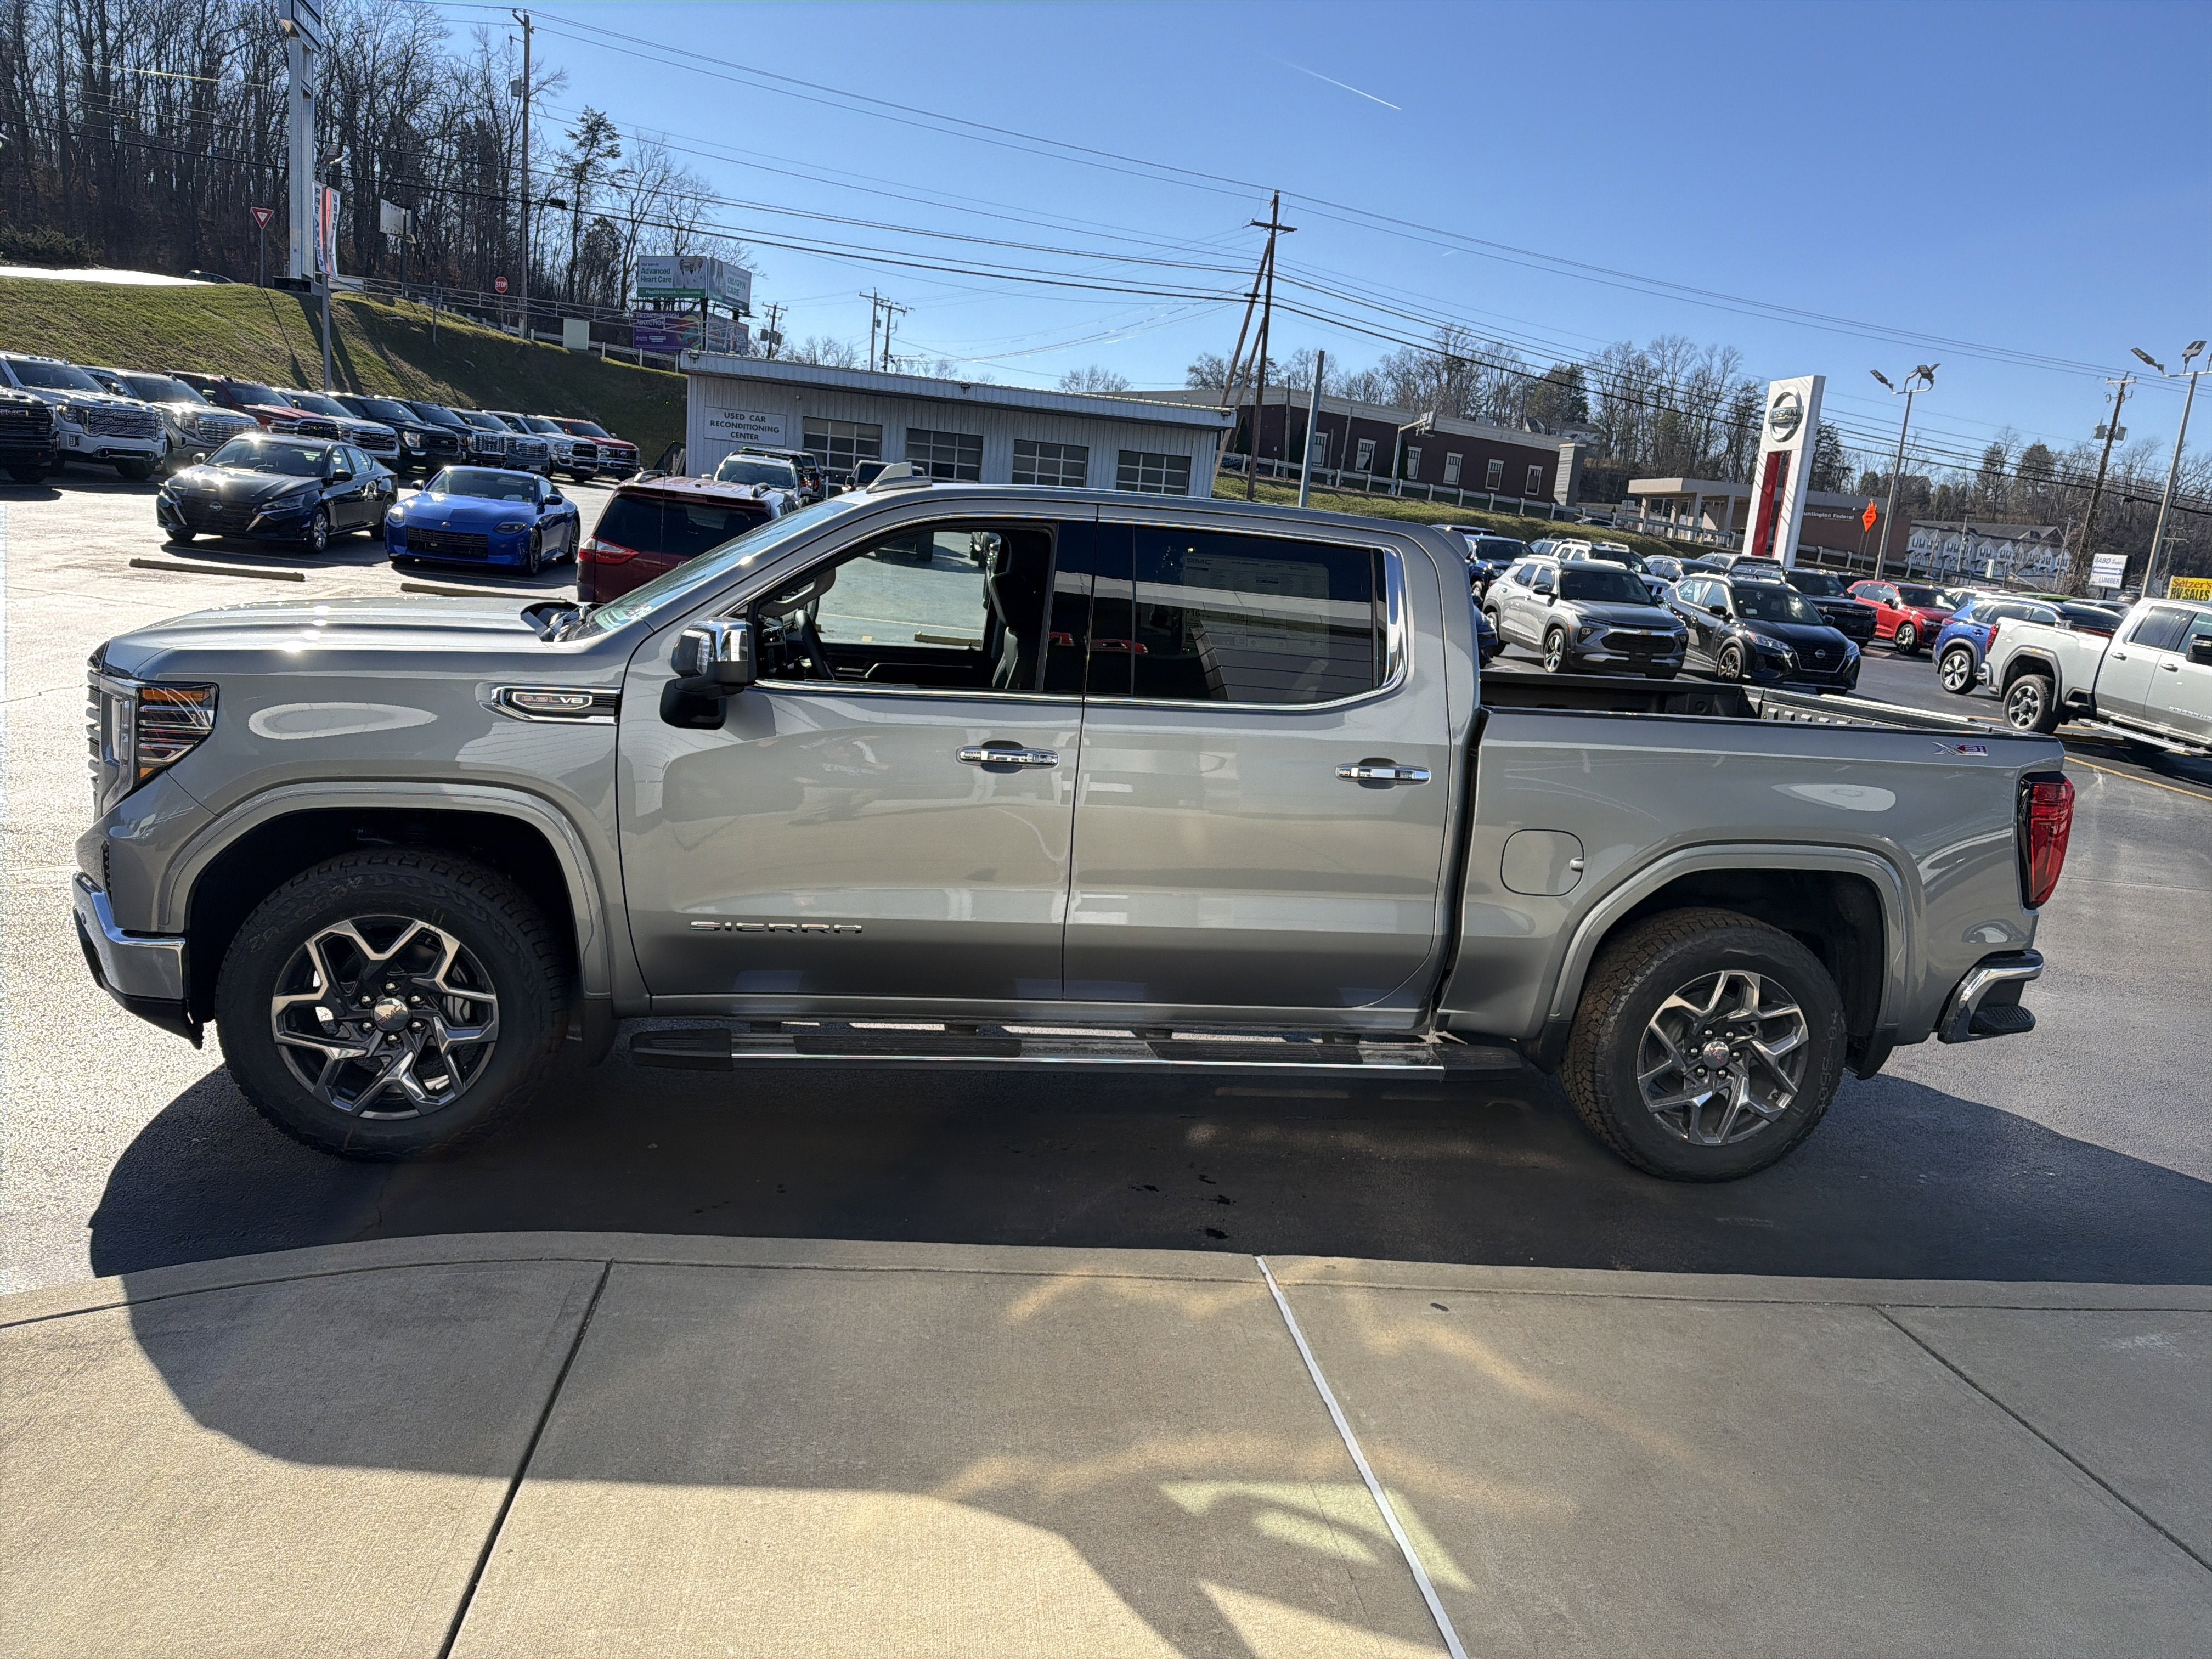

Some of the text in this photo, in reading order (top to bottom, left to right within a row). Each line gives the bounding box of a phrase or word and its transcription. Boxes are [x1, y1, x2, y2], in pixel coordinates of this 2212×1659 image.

[727, 276, 746, 289] OB/GYN
[727, 285, 740, 297] CARE
[724, 411, 766, 423] USED CAR
[710, 420, 780, 433] RECONDITIONING
[730, 431, 759, 441] CENTER
[2098, 576, 2120, 584] LUMBER
[2172, 578, 2212, 589] Setzer's
[2170, 587, 2210, 601] RV SALES
[690, 921, 862, 933] SIERRA
[379, 1004, 403, 1025] GMC
